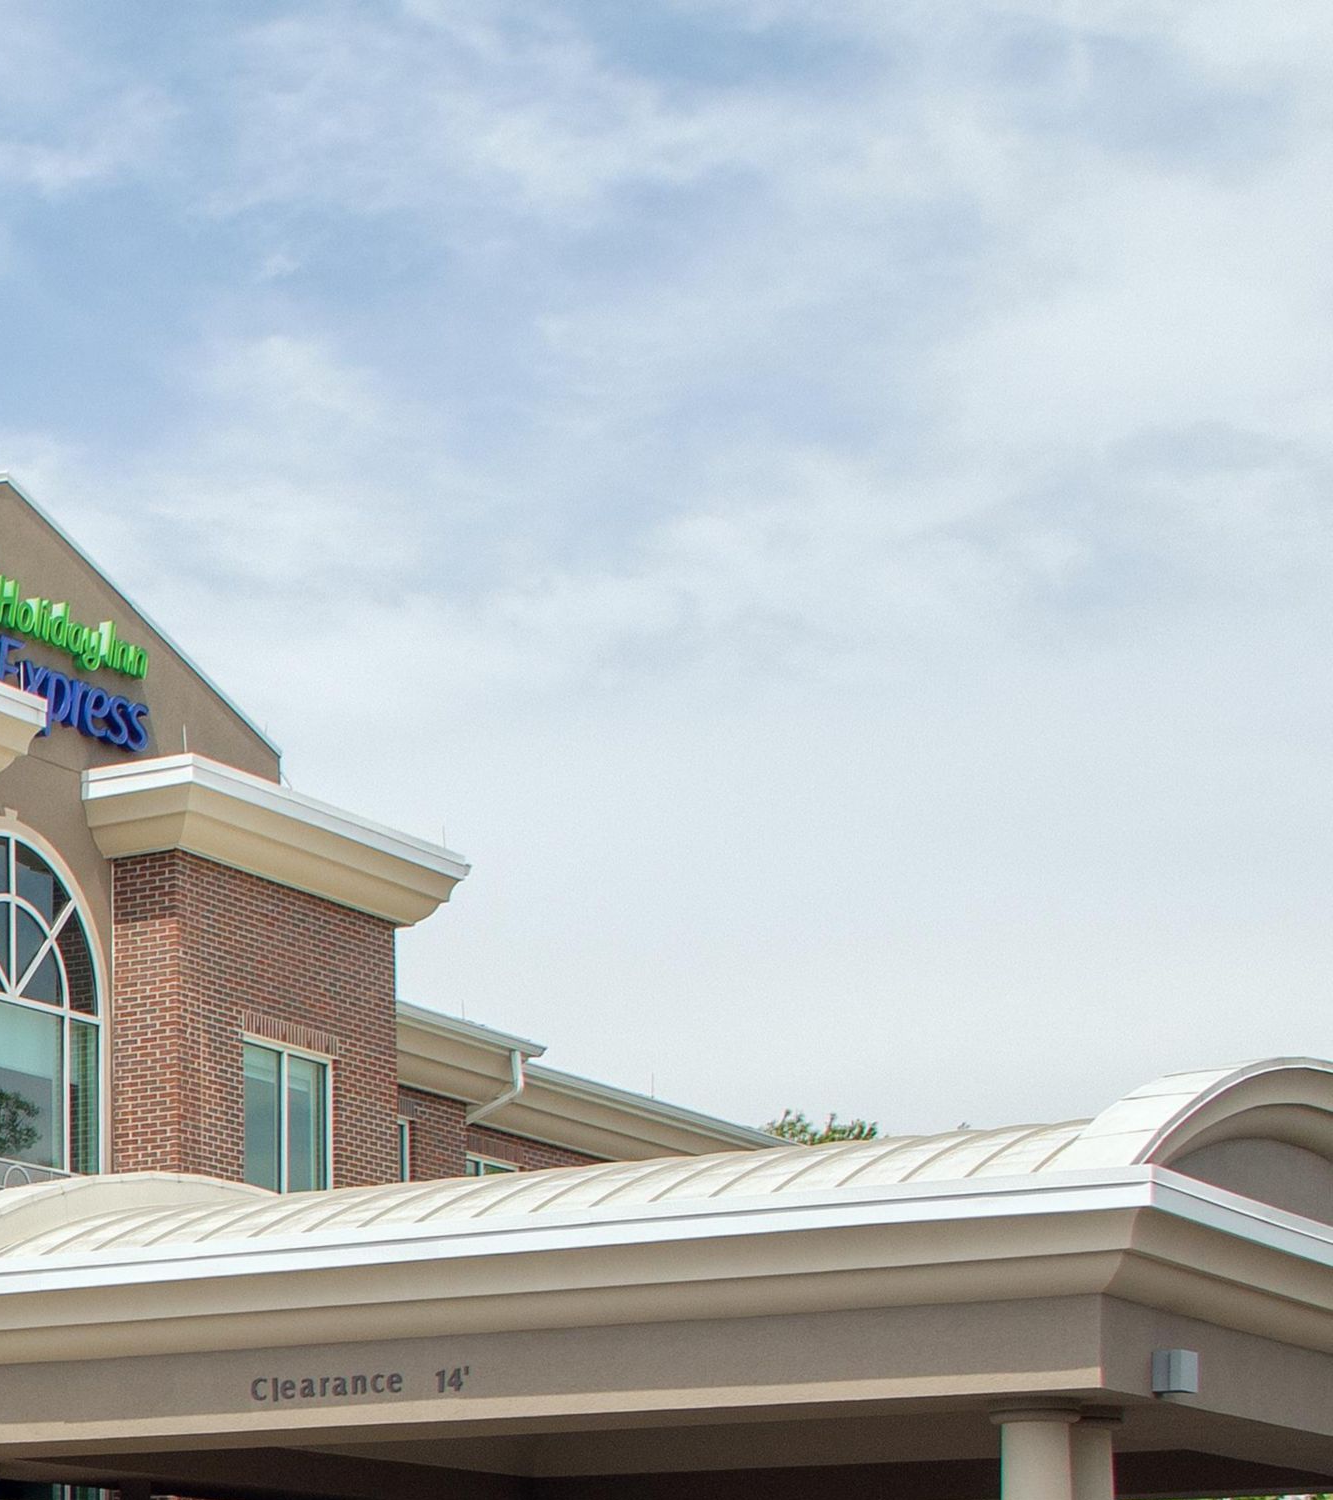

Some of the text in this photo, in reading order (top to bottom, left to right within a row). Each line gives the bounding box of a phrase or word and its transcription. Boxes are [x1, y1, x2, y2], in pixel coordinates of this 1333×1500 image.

[99, 620, 149, 680] Inn
[250, 1366, 470, 1402] Clearance 14'
